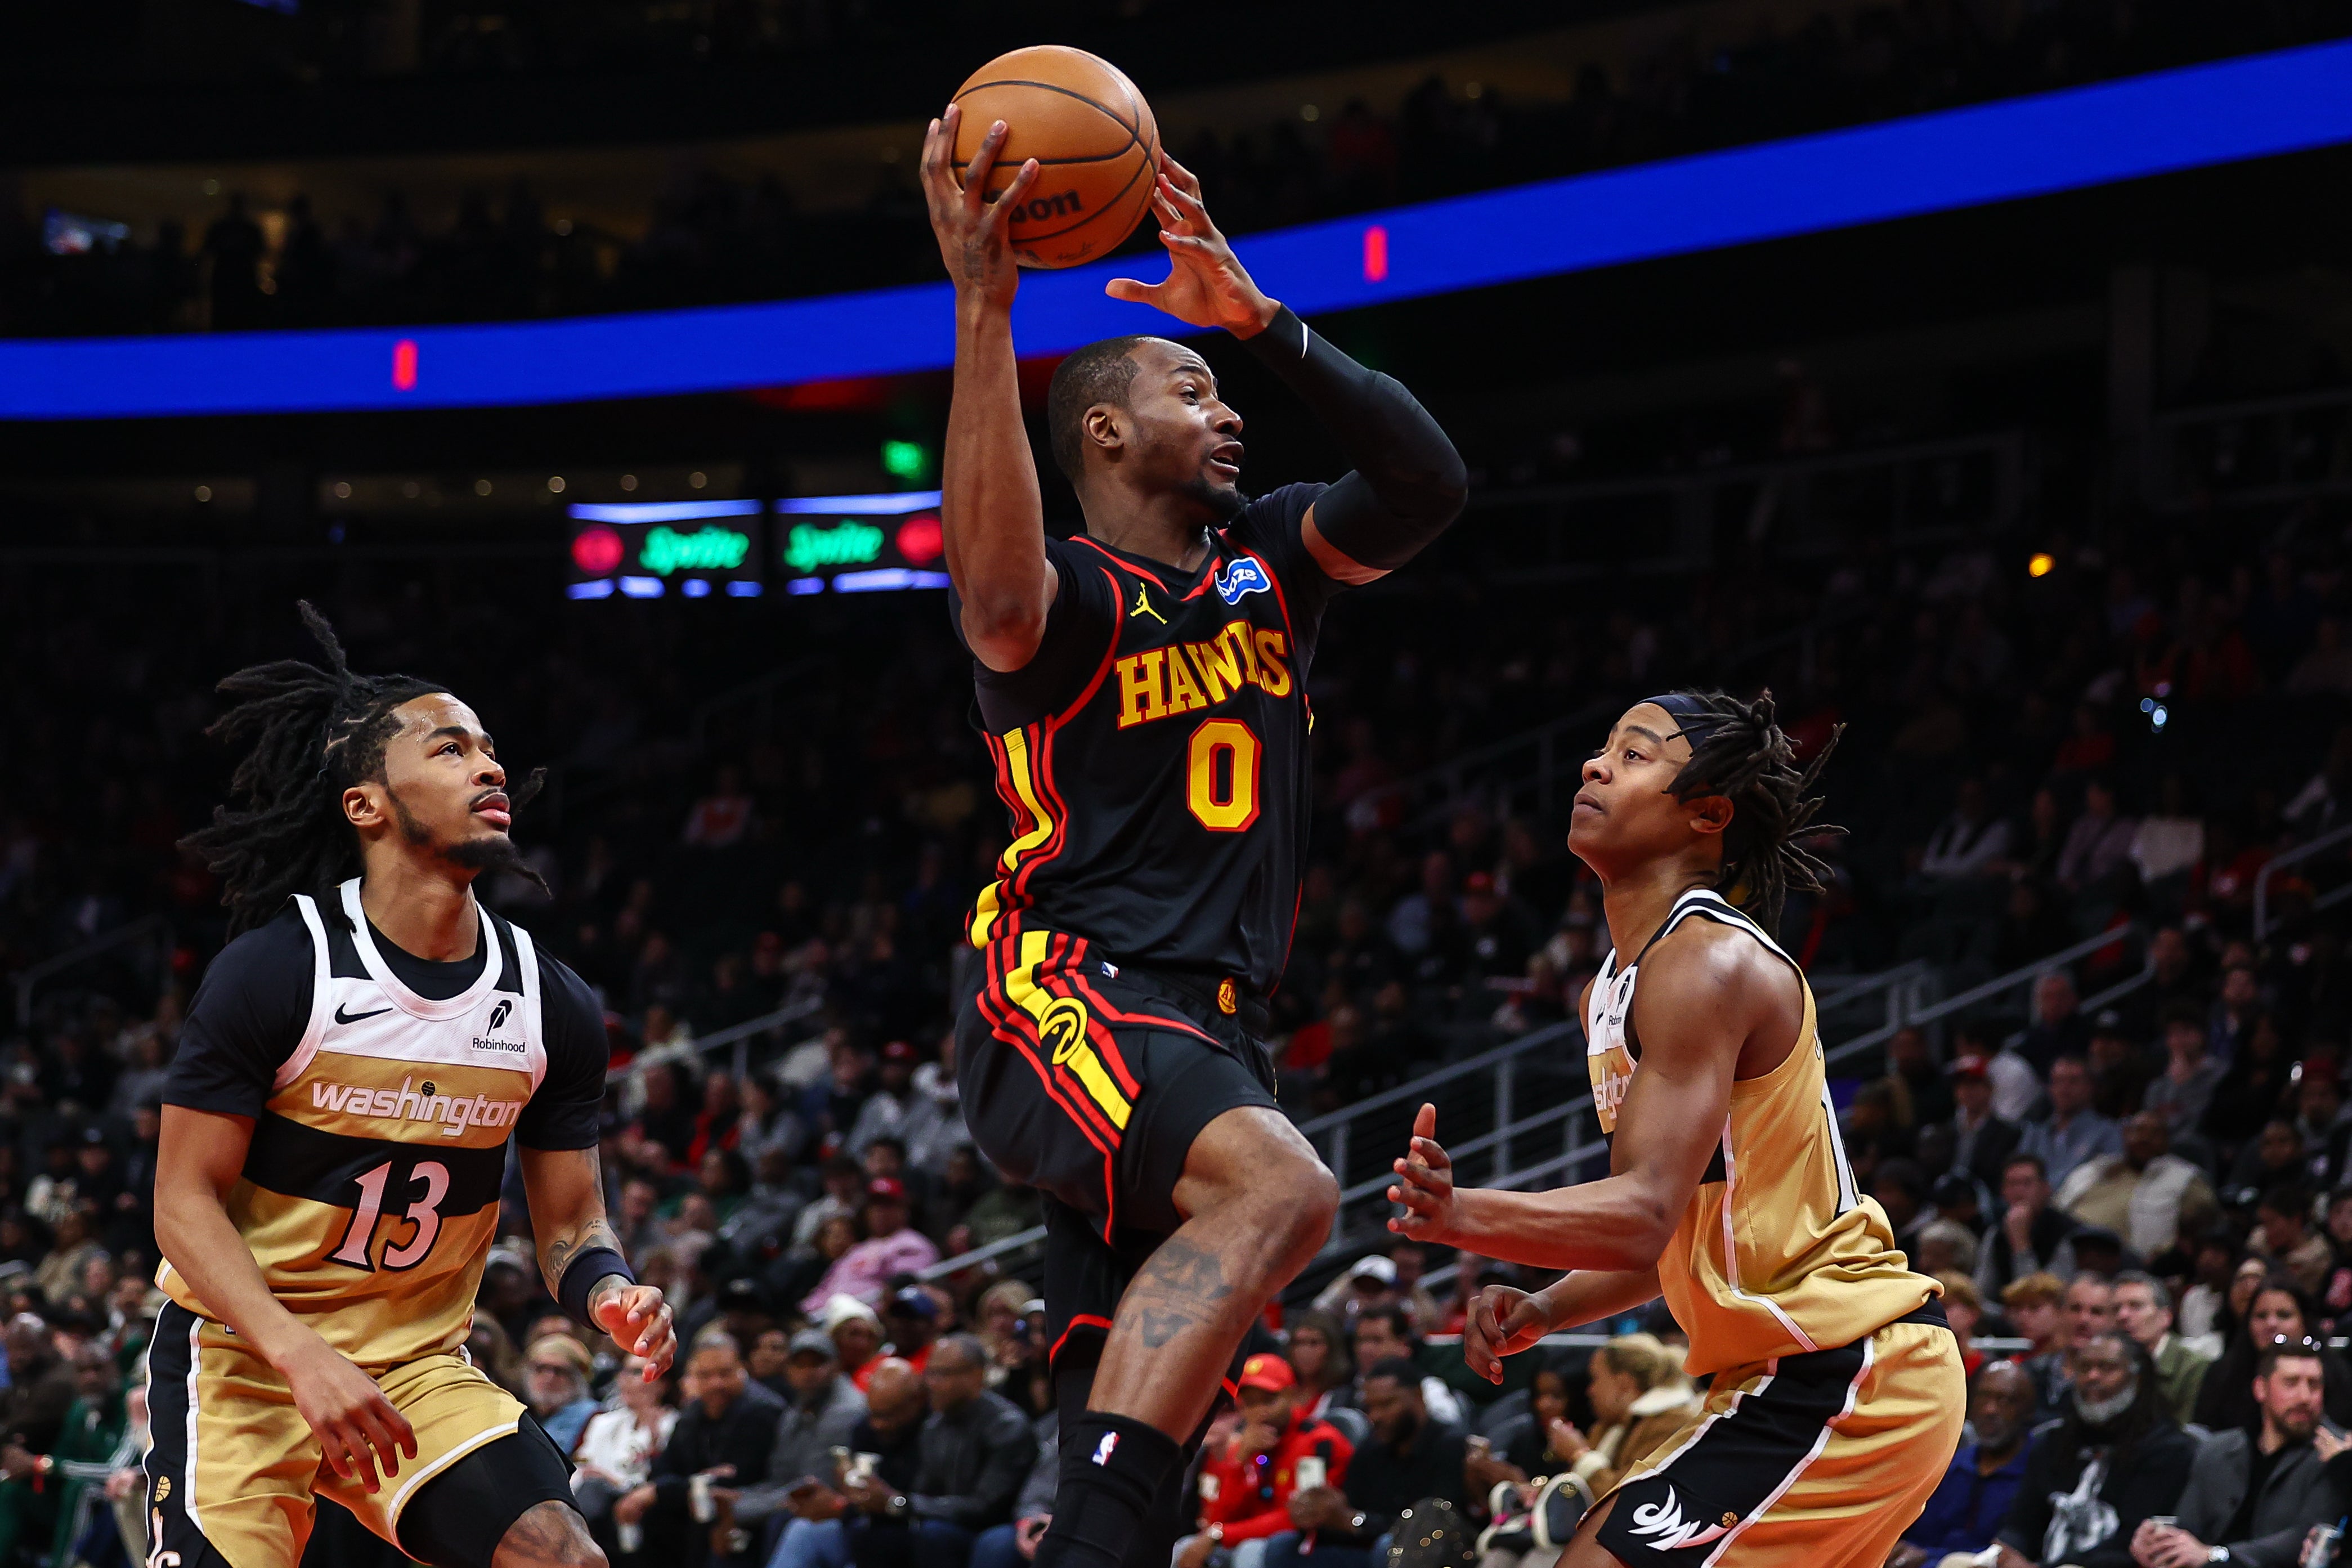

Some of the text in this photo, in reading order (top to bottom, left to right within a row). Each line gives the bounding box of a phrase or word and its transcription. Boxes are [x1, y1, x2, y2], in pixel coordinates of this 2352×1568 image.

[1186, 718, 1262, 832] 0
[472, 1037, 526, 1053] Robinhood
[312, 1072, 522, 1136] washington
[323, 1159, 451, 1273] 13
